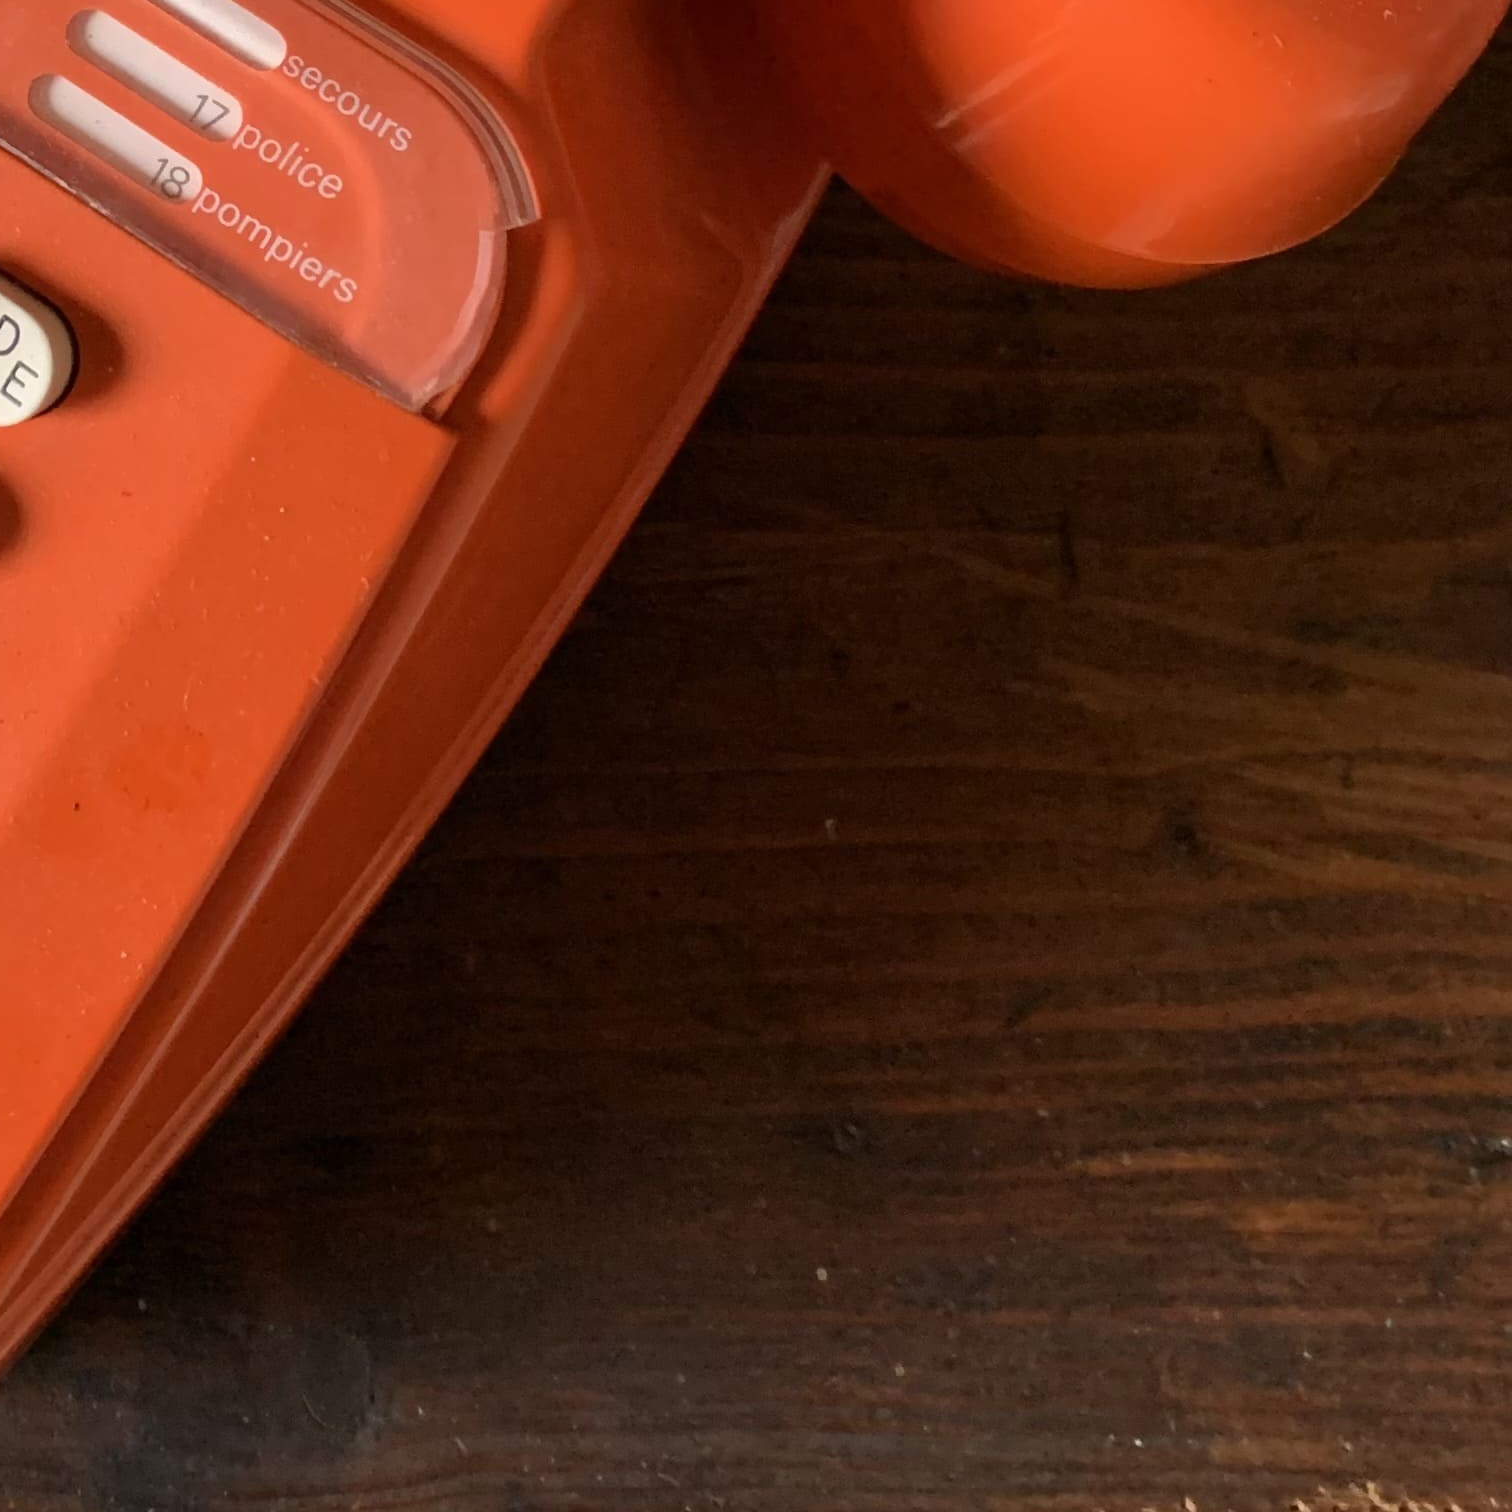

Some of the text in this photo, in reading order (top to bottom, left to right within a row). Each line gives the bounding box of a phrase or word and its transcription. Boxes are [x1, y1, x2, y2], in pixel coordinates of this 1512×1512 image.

[188, 94, 344, 200] 17 police
[281, 55, 414, 152] secours
[150, 157, 358, 304] 18 pompiers
[0, 362, 38, 407] E
